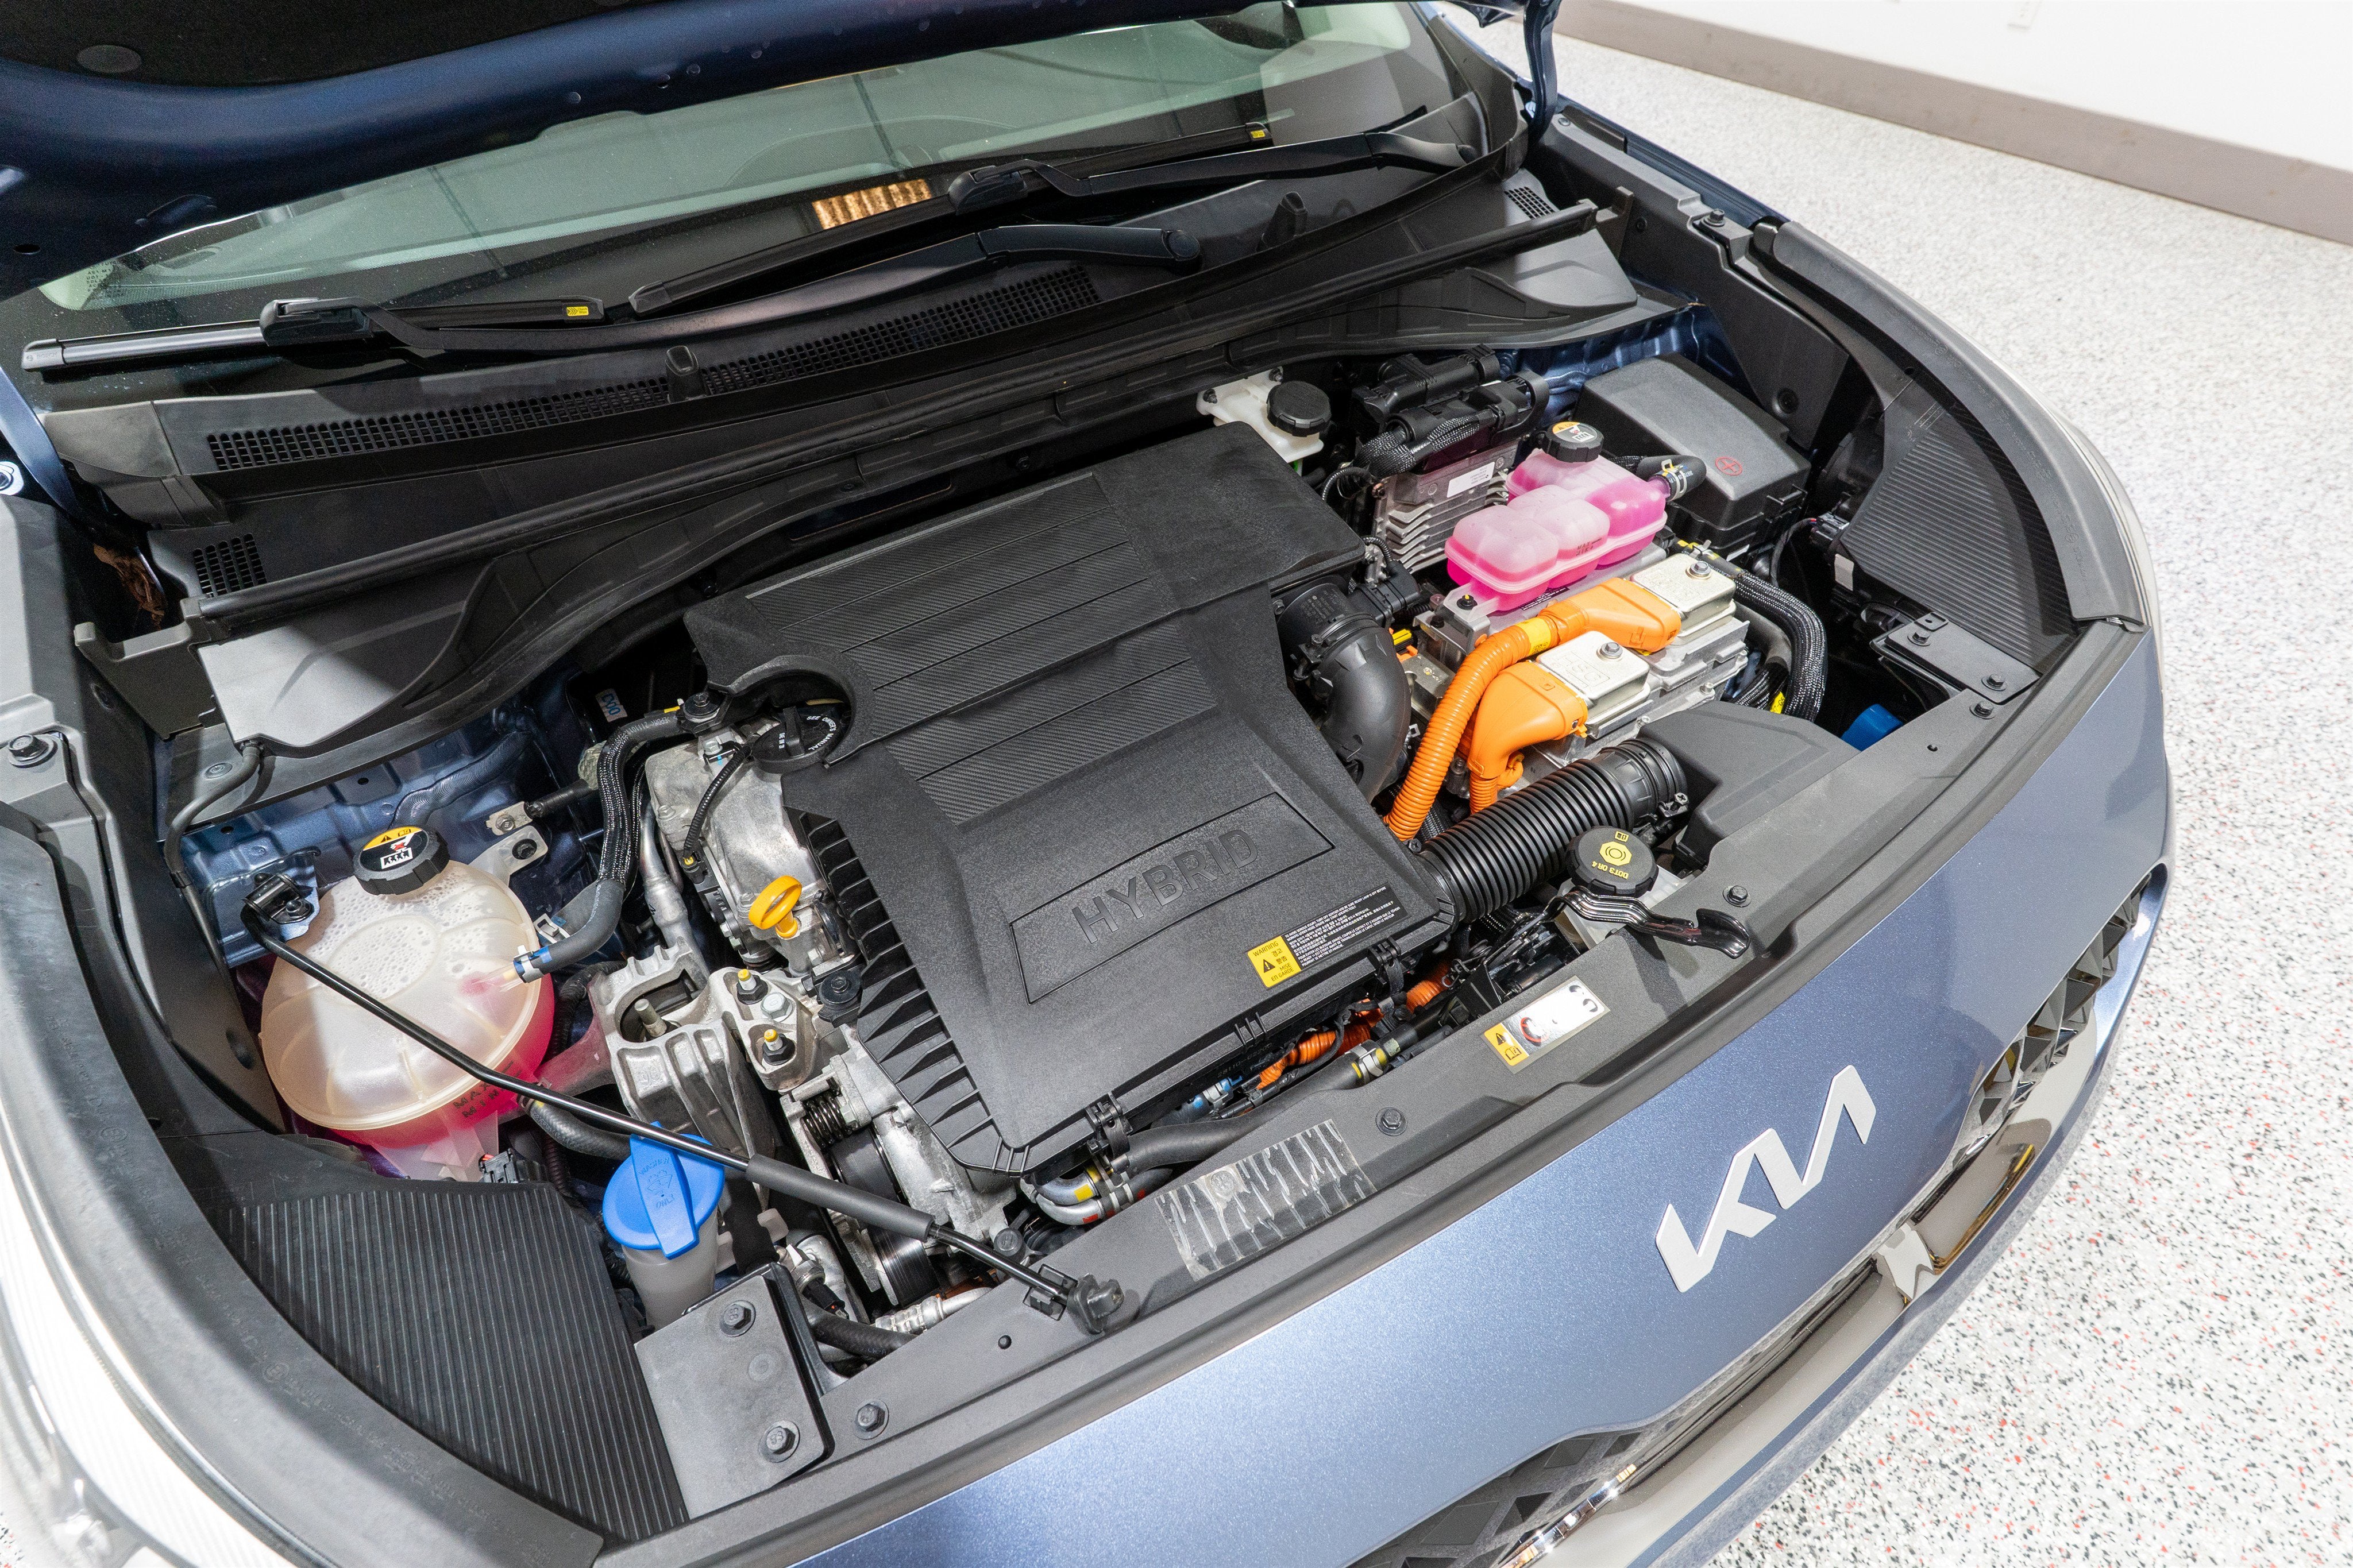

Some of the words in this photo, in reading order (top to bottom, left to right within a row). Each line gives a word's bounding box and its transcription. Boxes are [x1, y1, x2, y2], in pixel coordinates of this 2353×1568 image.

[821, 717, 837, 732] OWNER'S
[808, 733, 834, 751] MANUAL
[1597, 863, 1608, 872] OR
[1073, 829, 1259, 944] HYBRID
[1253, 941, 1279, 957] WARNING
[1271, 948, 1283, 957] 경고
[1276, 956, 1287, 965] 警告
[1279, 962, 1291, 971] MISE
[1271, 974, 1279, 982] EN
[1278, 967, 1294, 979] GARDE
[453, 1082, 492, 1109] MAX
[462, 1089, 500, 1118] MIN
[1656, 1064, 1876, 1293] KIA
[656, 1194, 675, 1208] ONLY
